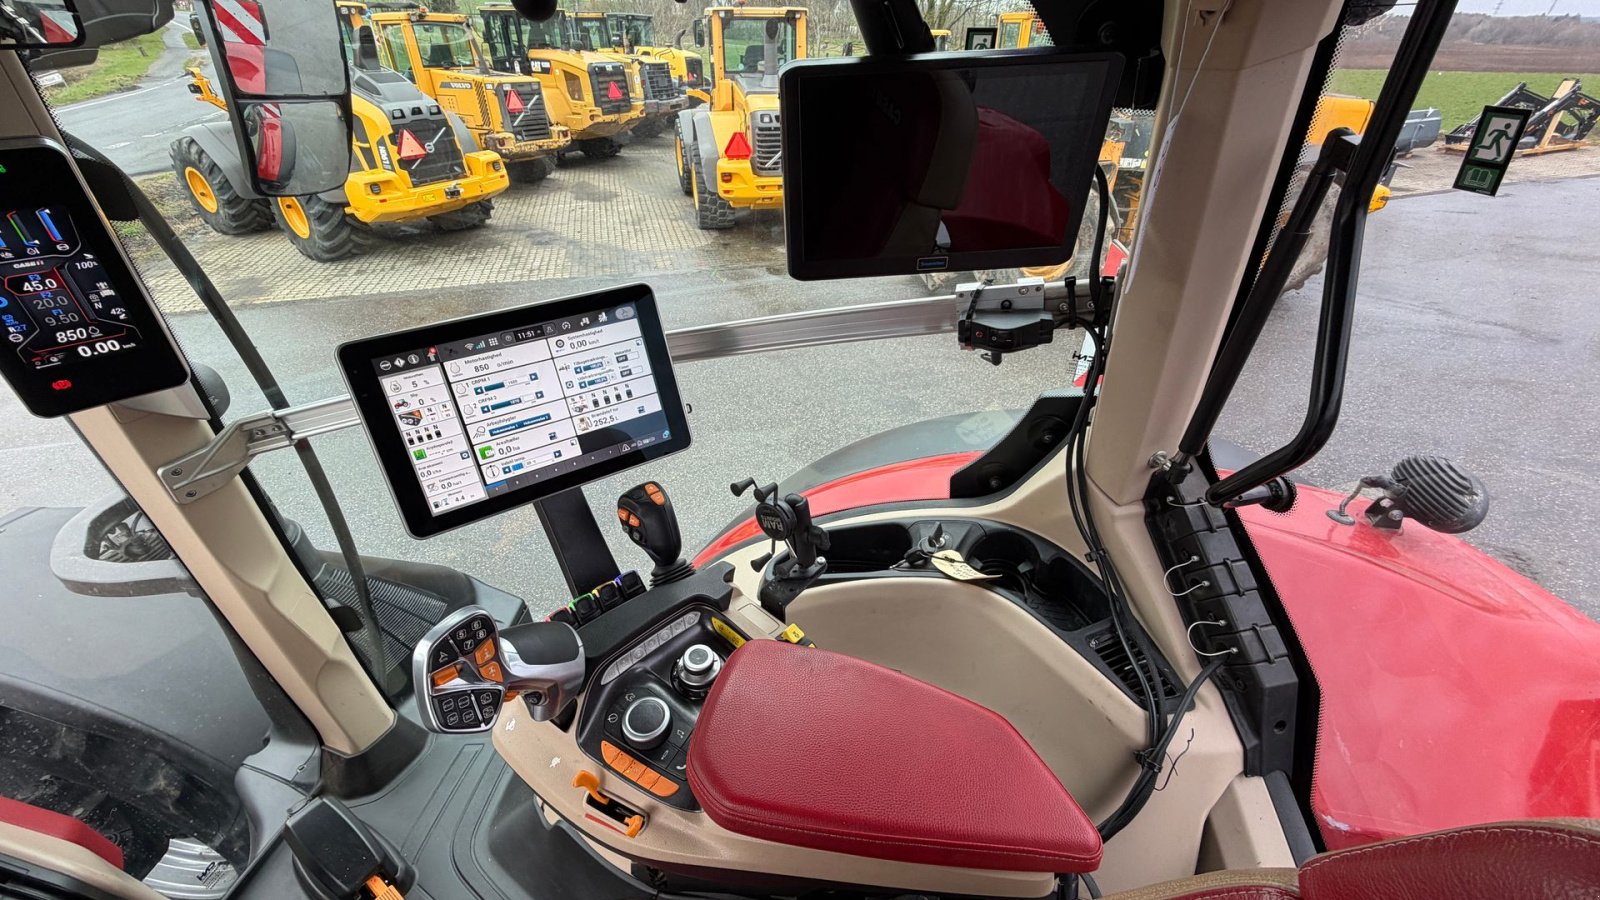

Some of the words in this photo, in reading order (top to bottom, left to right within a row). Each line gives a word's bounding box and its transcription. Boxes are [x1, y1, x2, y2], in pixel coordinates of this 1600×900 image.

[23, 279, 57, 292] 45.0
[33, 296, 68, 310] 20.0
[44, 312, 79, 327] 9.50
[56, 327, 87, 343] 850
[517, 330, 535, 340] 11:51
[77, 340, 120, 357] 0.00
[569, 340, 587, 350] 0,00
[474, 363, 490, 373] 850
[411, 380, 418, 388] 5
[418, 398, 425, 406] 0
[593, 416, 615, 427] 252,5
[498, 446, 512, 456] 0,0
[420, 469, 432, 478] 0,0
[440, 481, 453, 490] 0,0
